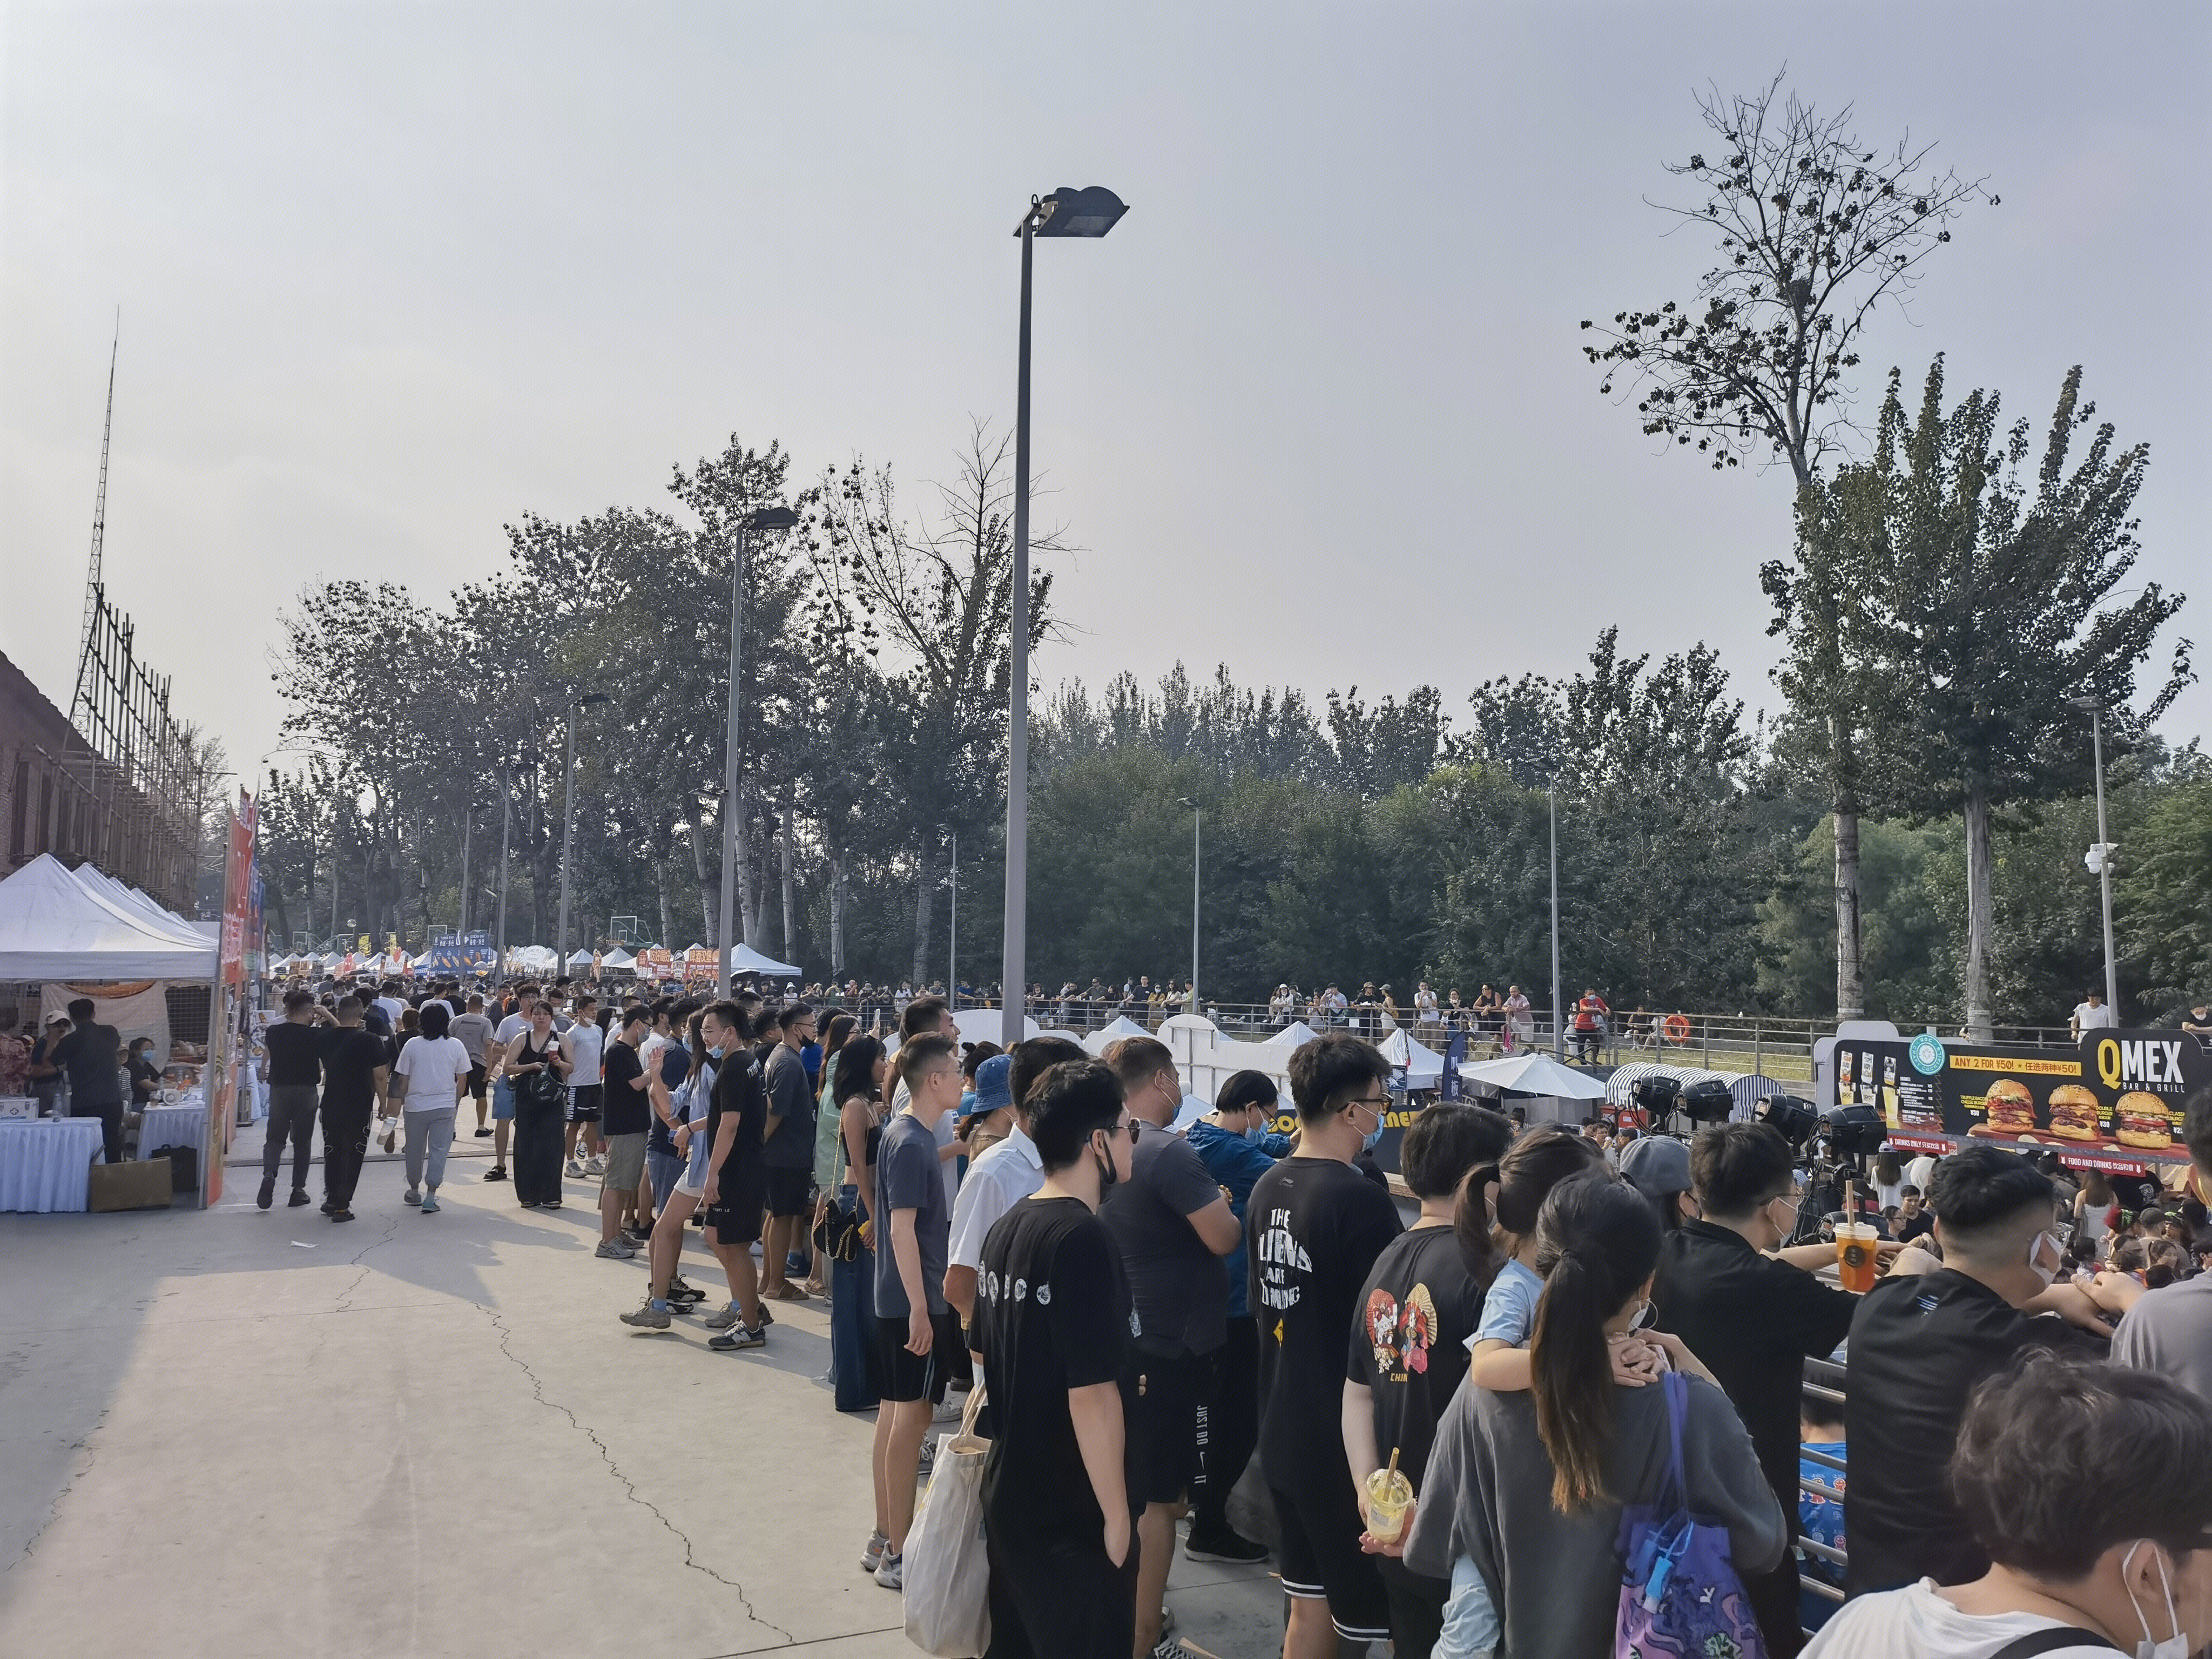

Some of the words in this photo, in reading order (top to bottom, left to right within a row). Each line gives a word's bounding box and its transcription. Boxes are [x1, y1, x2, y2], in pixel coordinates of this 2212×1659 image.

[690, 949, 712, 963] 啤酒汉堡
[1954, 1057, 1971, 1068] ANY
[1973, 1058, 1980, 1068] 2
[1981, 1059, 1994, 1069] FOR
[1996, 1060, 2014, 1070] ¥50!
[2098, 1038, 2184, 1090] QMEX
[2123, 1082, 2140, 1091] BAR
[2145, 1083, 2151, 1091] &
[2157, 1083, 2186, 1094] GRILL
[566, 1086, 577, 1120] JUMPMAN
[1894, 1138, 1911, 1147] DRINKS
[2068, 1157, 2081, 1166] FOOD
[2082, 1158, 2093, 1167] AND
[2093, 1160, 2112, 1169] DRINKS
[1271, 1208, 1291, 1229] THE
[1266, 1267, 1285, 1285] ARE
[1196, 1405, 1208, 1428] JUST
[1196, 1431, 1209, 1445] DO
[1194, 1474, 1207, 1485] IT
